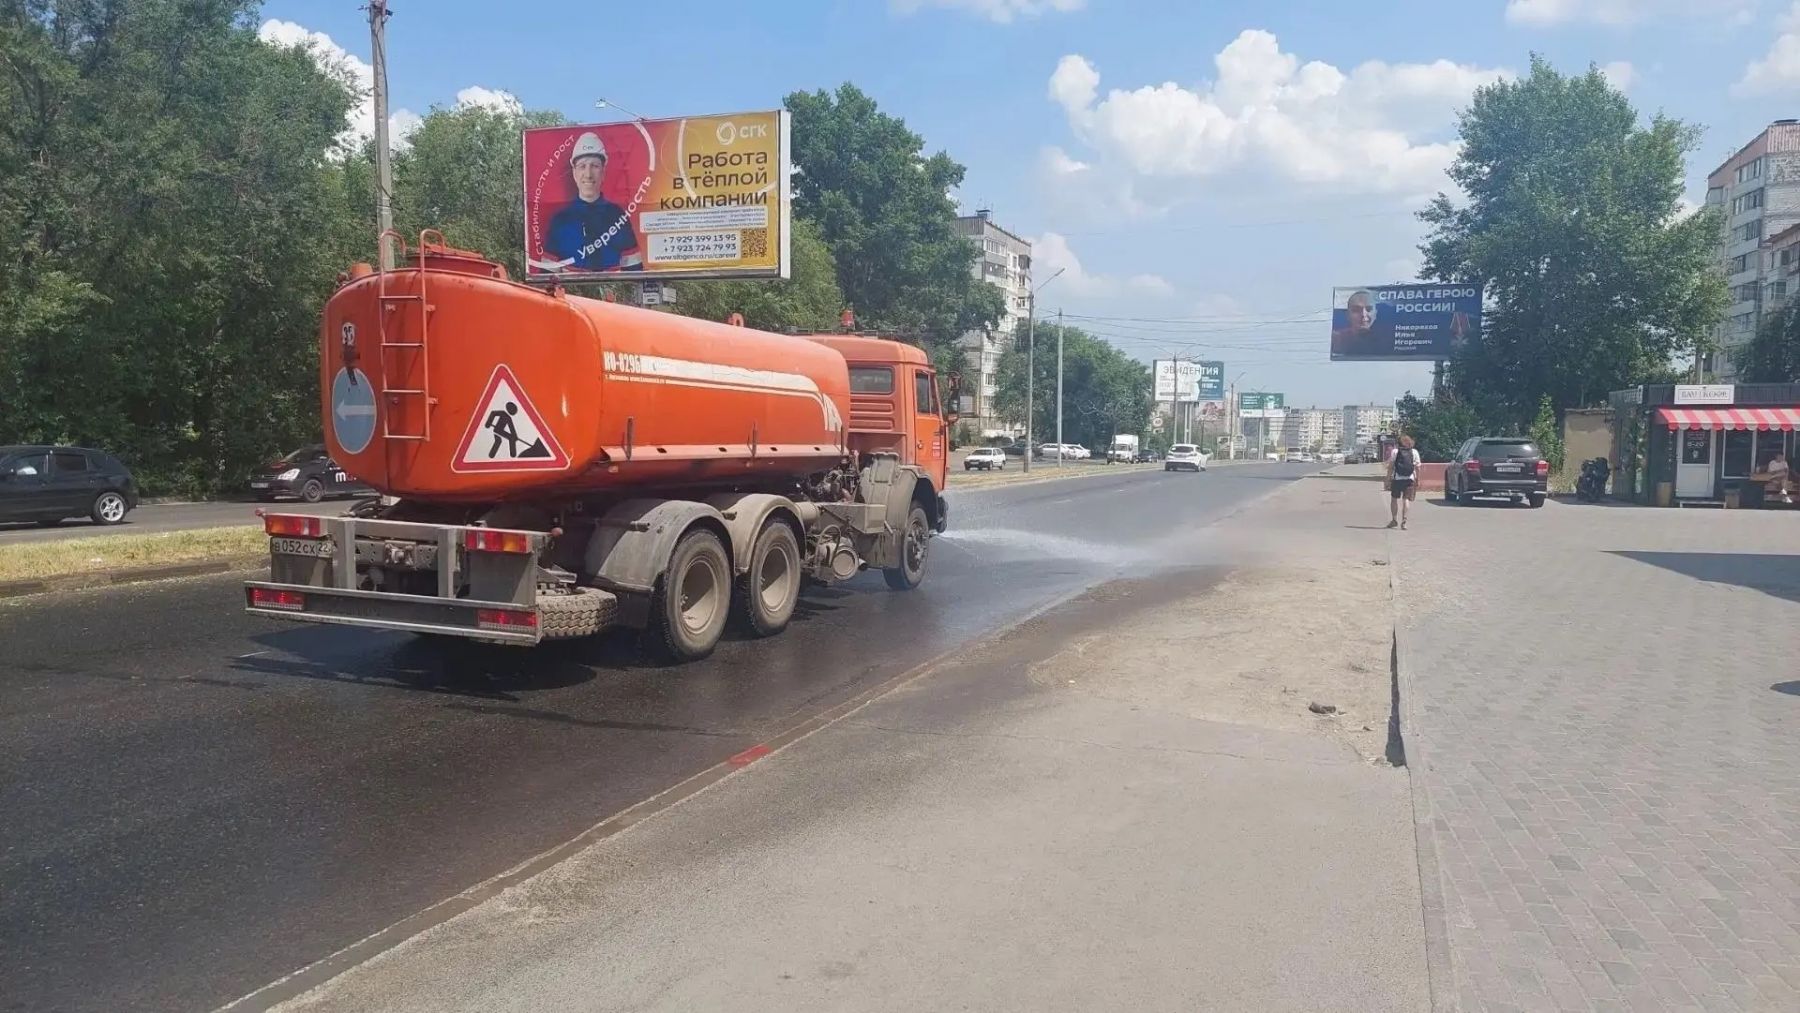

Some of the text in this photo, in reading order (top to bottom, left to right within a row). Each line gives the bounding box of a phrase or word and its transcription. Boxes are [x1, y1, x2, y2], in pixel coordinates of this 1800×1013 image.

[739, 123, 768, 139] СГК
[688, 151, 768, 169] Работа
[673, 168, 768, 190] в тёплой
[532, 169, 550, 255] Стабильность
[553, 135, 575, 160] рост
[660, 190, 768, 210] компании
[577, 176, 652, 260] Уверенность
[1378, 287, 1476, 301] СЛАВА ГЕРОЮ
